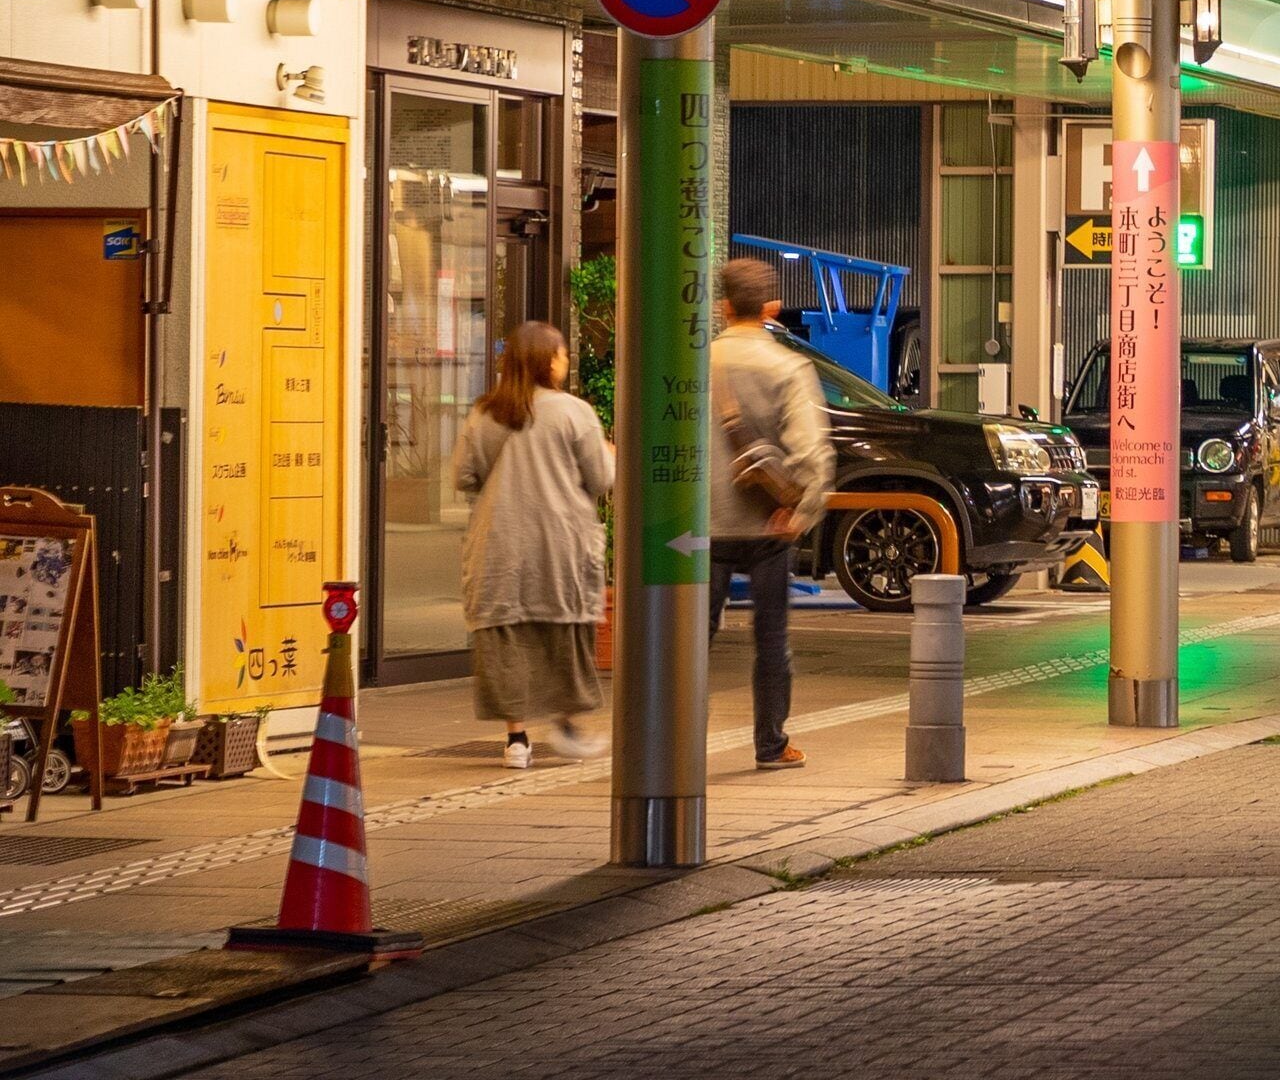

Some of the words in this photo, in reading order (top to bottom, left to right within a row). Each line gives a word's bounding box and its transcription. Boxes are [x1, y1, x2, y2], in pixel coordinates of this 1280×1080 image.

[680, 93, 709, 350] 四つ葉こみち
[1117, 206, 1140, 431] 本町三丁目商店街へ
[1112, 438, 1160, 451] Welcome
[1163, 442, 1173, 451] to
[1112, 453, 1165, 465] Honmachi
[1125, 468, 1137, 478] st.
